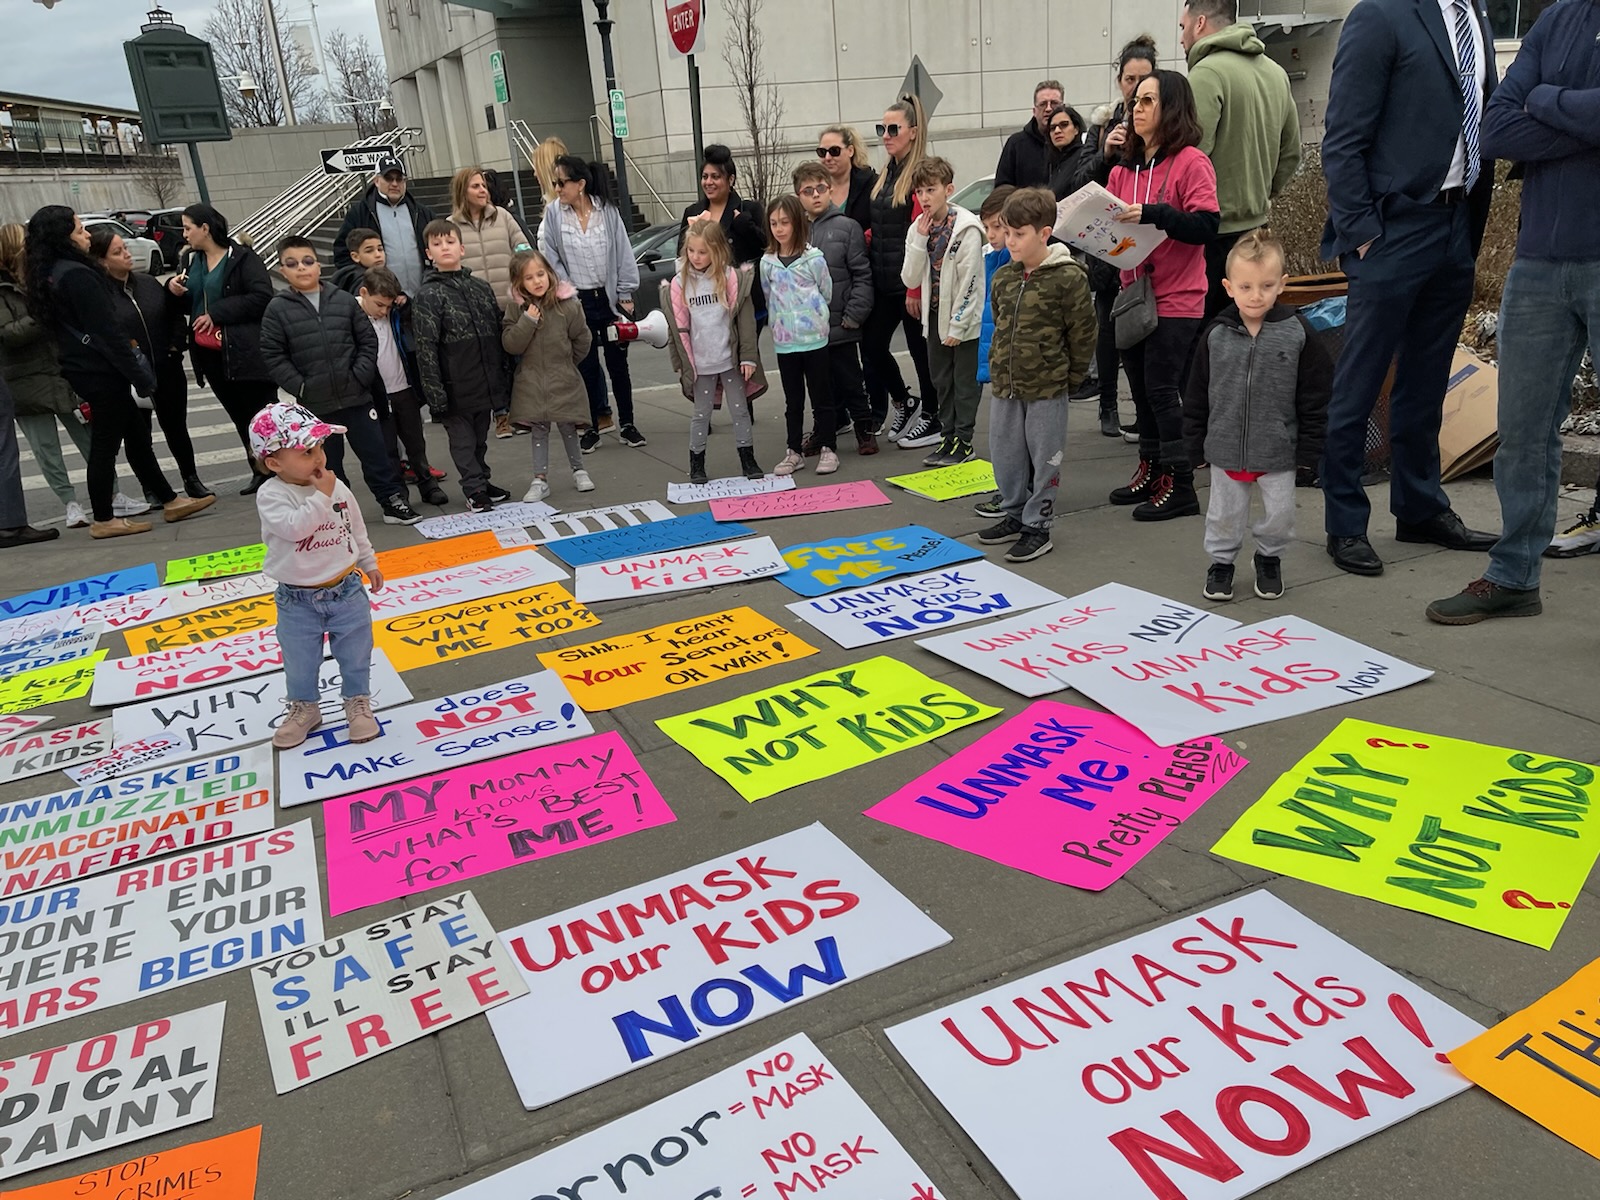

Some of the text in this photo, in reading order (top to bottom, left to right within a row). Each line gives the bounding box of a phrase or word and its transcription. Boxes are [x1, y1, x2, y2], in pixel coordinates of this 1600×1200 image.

[672, 9, 694, 32] ENTER
[344, 154, 365, 165] ONE
[295, 535, 341, 552] Mouse
[314, 521, 336, 532] nie
[601, 546, 749, 575] UNMASK
[743, 562, 779, 577] NOW
[783, 537, 907, 569] FREE
[811, 536, 945, 586] ME Please!
[1, 574, 119, 614] WHY
[370, 566, 530, 611] Kids NOW
[373, 563, 506, 596] UNMASK
[810, 571, 976, 614] UNMASK
[400, 600, 573, 647] WHY NOT
[851, 604, 897, 619] our
[863, 593, 1012, 637] NOW
[964, 604, 1116, 652] UNMASK
[117, 628, 276, 671] UNMASK
[137, 643, 280, 676] our KiD
[435, 635, 493, 658] ME
[557, 642, 633, 663] Shhh...
[637, 631, 662, 645] I
[563, 627, 790, 687] Your Senators
[667, 628, 732, 650] hear
[999, 604, 1197, 681] Kids NOW
[1111, 626, 1317, 682] UNMASK
[23, 668, 95, 692] Kids
[135, 652, 284, 697] NOW
[434, 682, 530, 713] does
[665, 668, 709, 685] OH
[1162, 660, 1391, 714] Kids NOW
[151, 683, 270, 729] WHY
[416, 692, 537, 737] NOT
[689, 670, 870, 739] WHY
[12, 741, 105, 775] KIDS
[76, 741, 181, 782] MANDATORY
[105, 753, 165, 776] MASKS
[133, 740, 169, 753] NO
[304, 703, 577, 790] MAKE Sense!
[723, 724, 828, 775] NOT
[915, 717, 1094, 820] UNMASK
[350, 748, 614, 834] MY MOMMY
[1061, 740, 1213, 868] Pretty PLEASE
[1251, 753, 1409, 863] WHY
[0, 789, 269, 871] VACCINATED
[363, 771, 640, 863] WHAT'S BEST
[0, 821, 233, 896] NAFRAID
[116, 830, 295, 897] RIGHTS
[397, 853, 477, 887] for
[1385, 814, 1501, 909] NOT
[167, 865, 272, 912] END
[170, 886, 306, 942] YOUR
[259, 894, 467, 979] YOU STAY
[509, 856, 798, 973] UNMASK
[138, 918, 306, 993] BEGIN
[272, 914, 478, 1012] SAFE
[581, 944, 671, 994] our
[284, 940, 494, 1036] I'LL STAY
[612, 936, 847, 1063] NOW
[941, 916, 1298, 1067] UNMASK
[289, 967, 510, 1081] FREE
[1081, 971, 1367, 1104] our Kids
[746, 1052, 795, 1087] NO
[752, 1063, 834, 1120] MASK
[74, 1155, 159, 1196] STOP
[761, 1132, 816, 1174] NO
[774, 1135, 879, 1200] MASK
